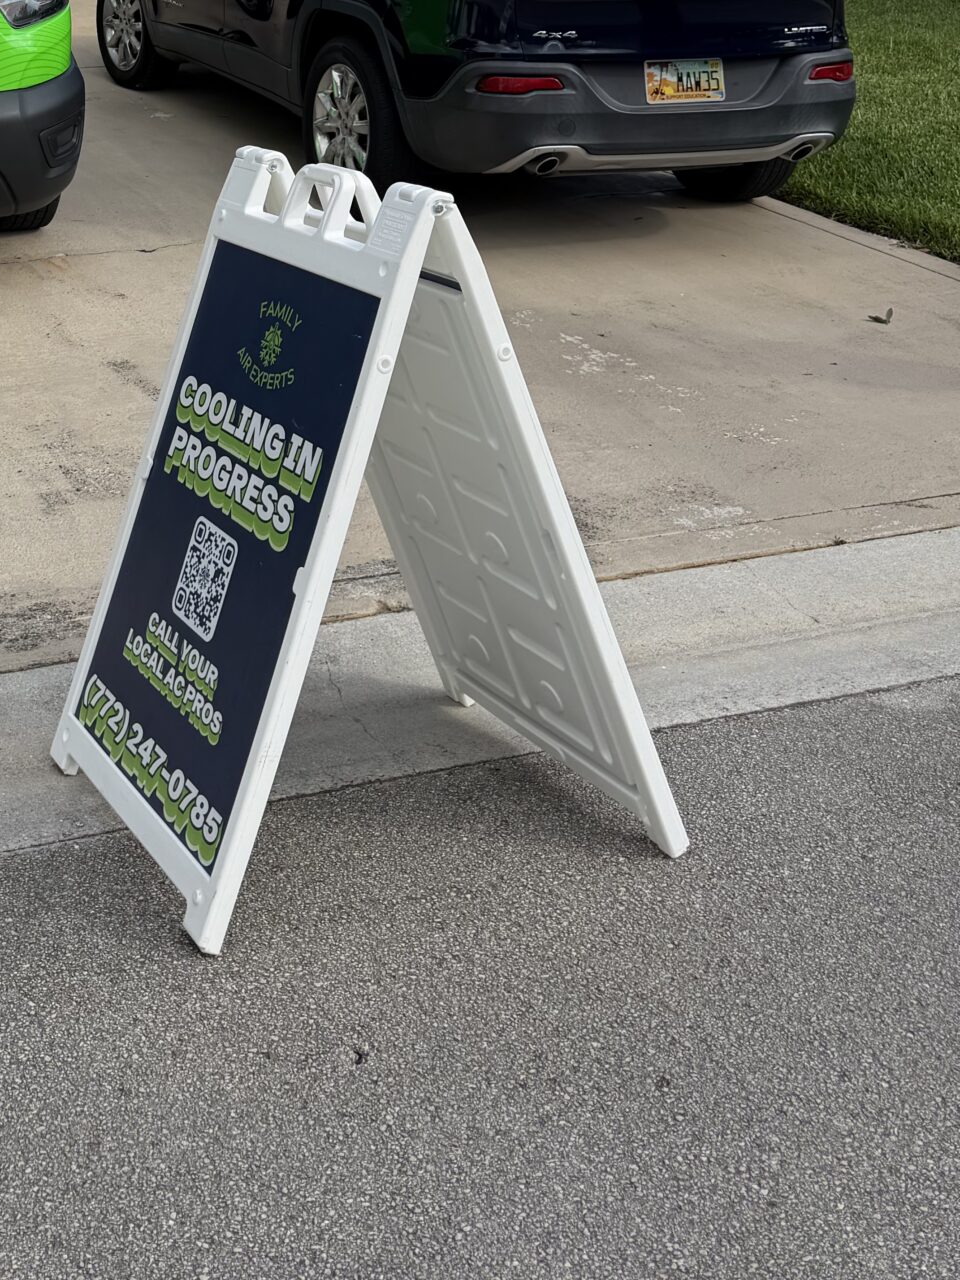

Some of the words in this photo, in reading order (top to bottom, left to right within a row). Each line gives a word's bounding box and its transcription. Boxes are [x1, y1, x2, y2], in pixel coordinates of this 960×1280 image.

[532, 30, 578, 39] 4x4
[784, 25, 828, 35] LIMITED
[259, 300, 302, 333] FAMILY
[236, 346, 253, 375] AIR
[248, 367, 295, 390] EXPERTS
[178, 375, 287, 464] COOLING
[282, 432, 324, 487] IN
[167, 425, 296, 538] PROGRESS
[124, 627, 164, 681] LOCAL
[163, 667, 186, 699] AC
[183, 683, 224, 737] PROS
[146, 612, 180, 657] CALL
[180, 639, 219, 691] YOUR
[82, 673, 131, 745] (772)
[126, 722, 224, 845] 247-0785
